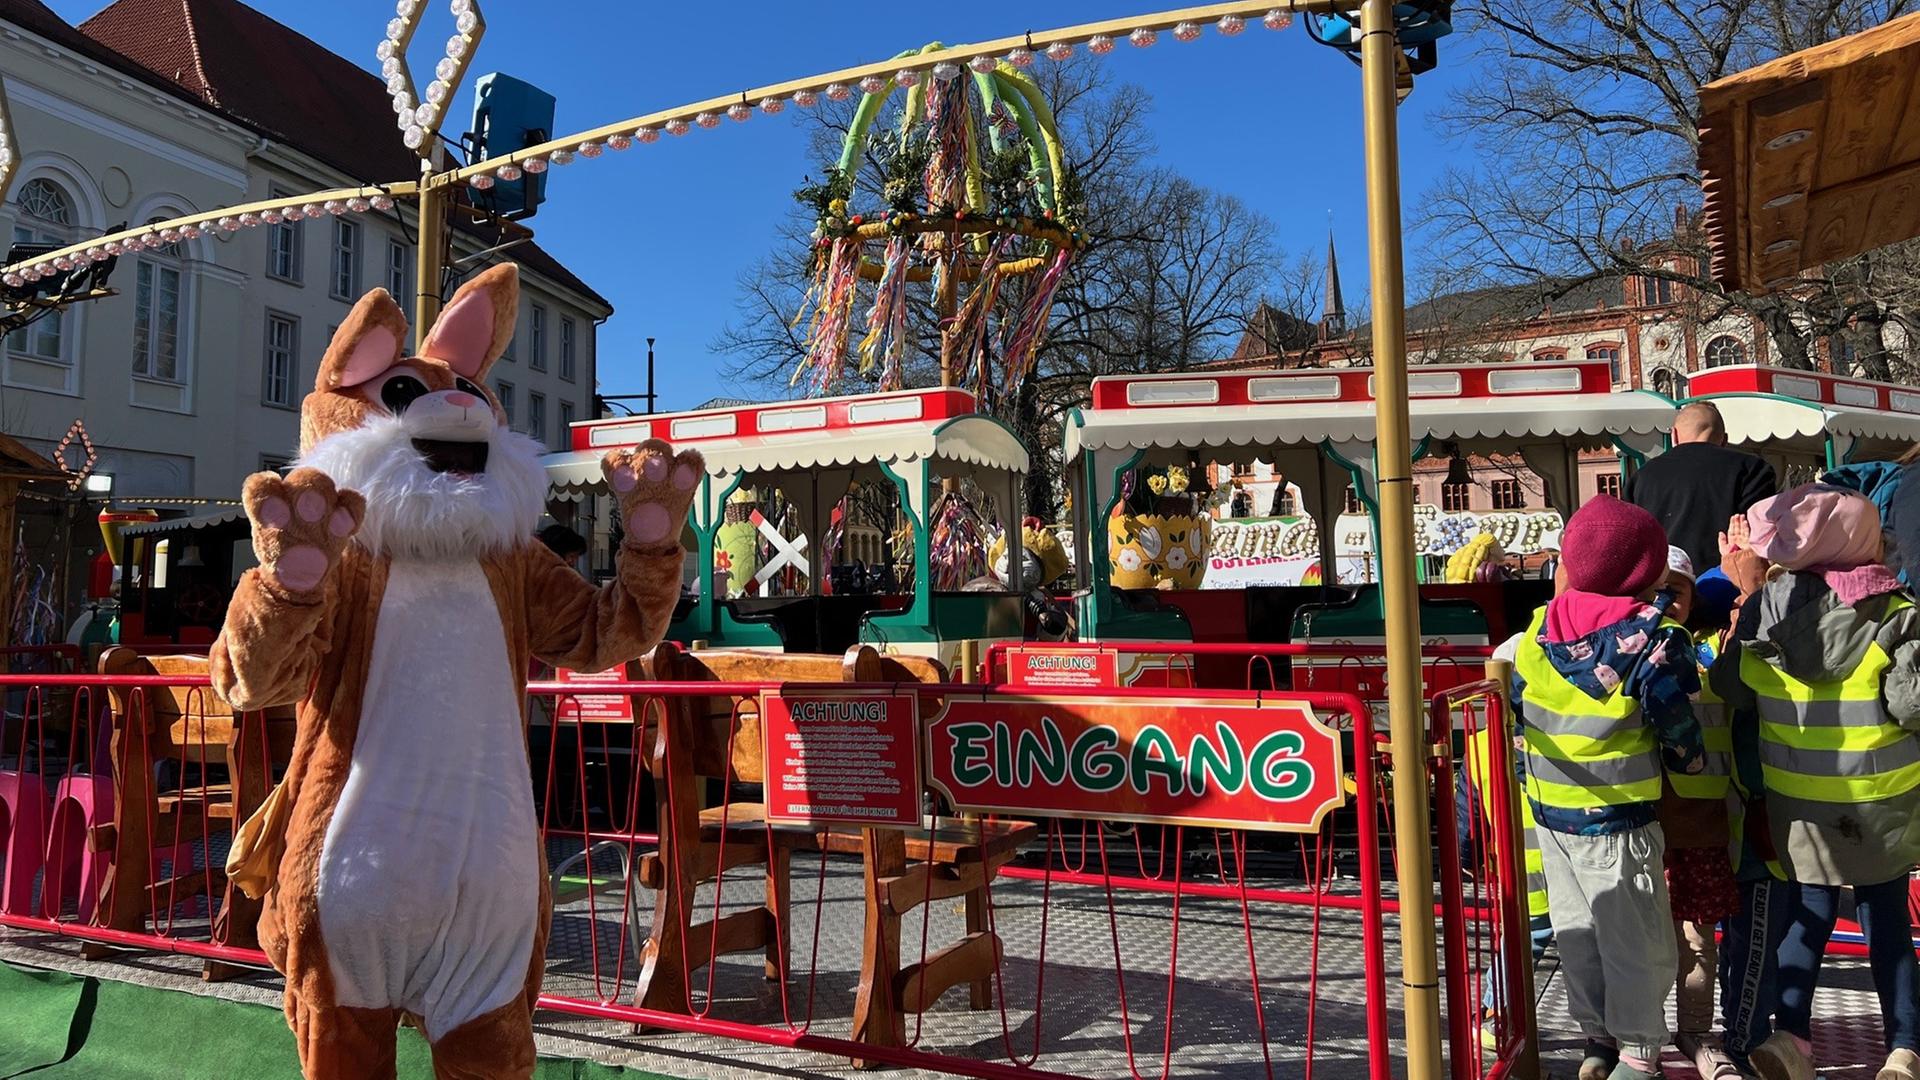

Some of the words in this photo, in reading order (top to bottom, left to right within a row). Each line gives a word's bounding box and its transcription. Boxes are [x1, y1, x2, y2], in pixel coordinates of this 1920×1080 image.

[1027, 655, 1097, 670] ACHTUNG!
[790, 701, 887, 722] ACHTUNG!
[947, 716, 1315, 802] EINGANG
[1754, 887, 1768, 919] READY
[1752, 928, 1764, 949] GET
[1747, 949, 1763, 979] READY
[1742, 988, 1755, 1008] GET
